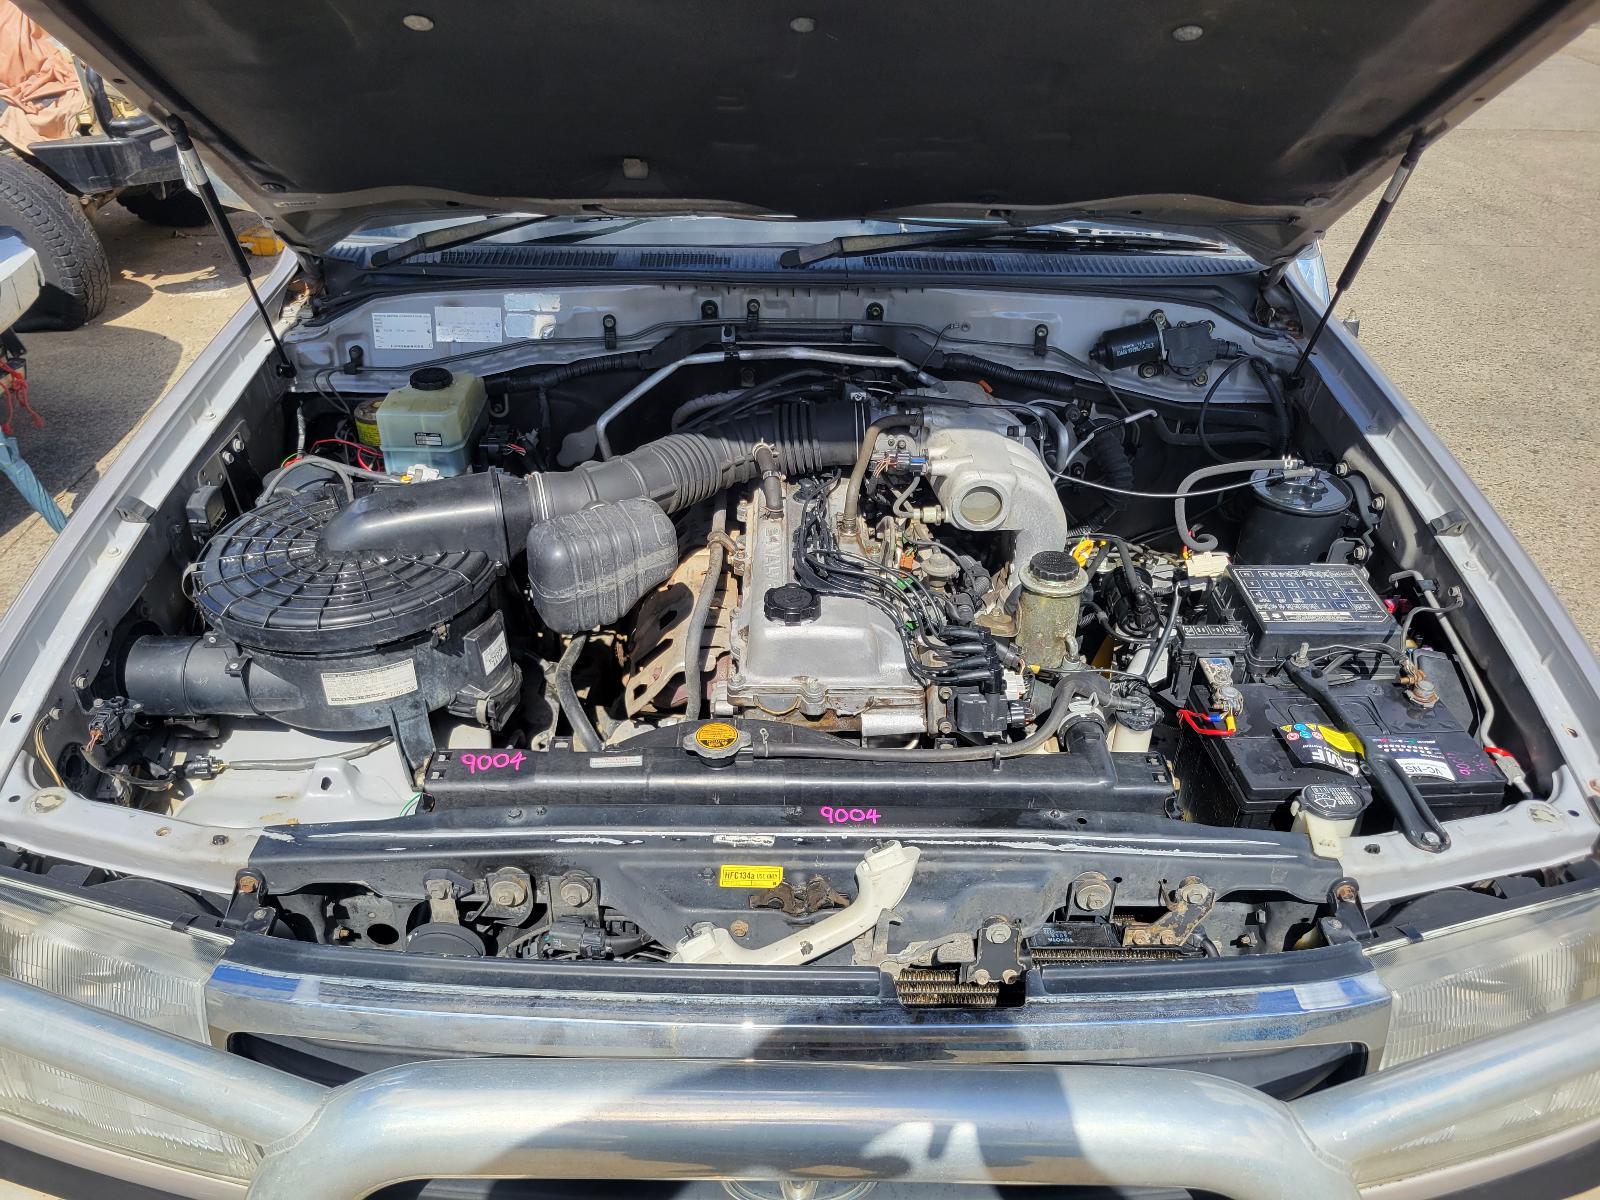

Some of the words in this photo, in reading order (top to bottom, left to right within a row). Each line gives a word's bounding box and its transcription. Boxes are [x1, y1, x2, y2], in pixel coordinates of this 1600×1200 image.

[461, 751, 527, 774] 9004
[1311, 748, 1359, 776] CMF
[820, 806, 882, 824] 9004
[725, 871, 755, 880] HFC134a
